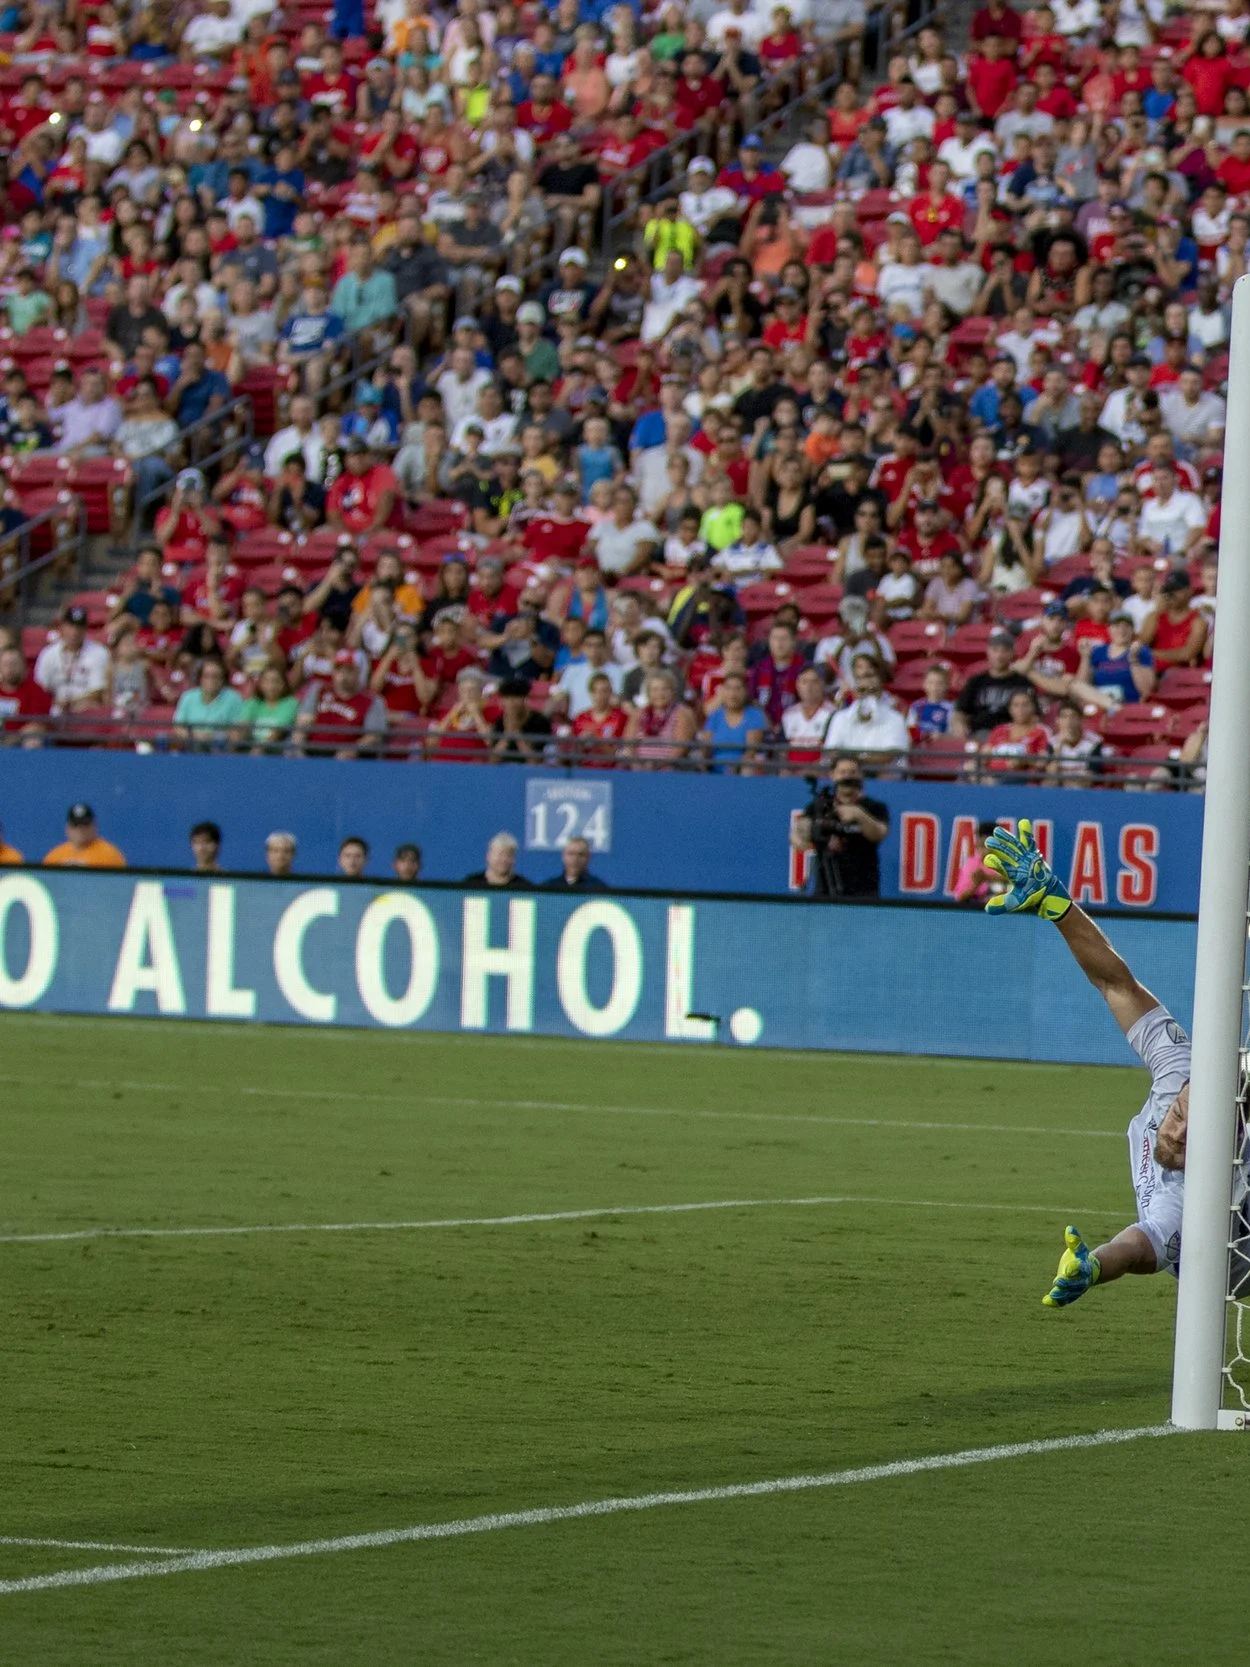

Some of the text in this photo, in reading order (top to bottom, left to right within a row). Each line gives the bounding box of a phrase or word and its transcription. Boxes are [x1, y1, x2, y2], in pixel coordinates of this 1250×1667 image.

[530, 803, 606, 850] 124
[899, 811, 1160, 907] DAAS
[107, 881, 765, 1043] ALCOHOL.
